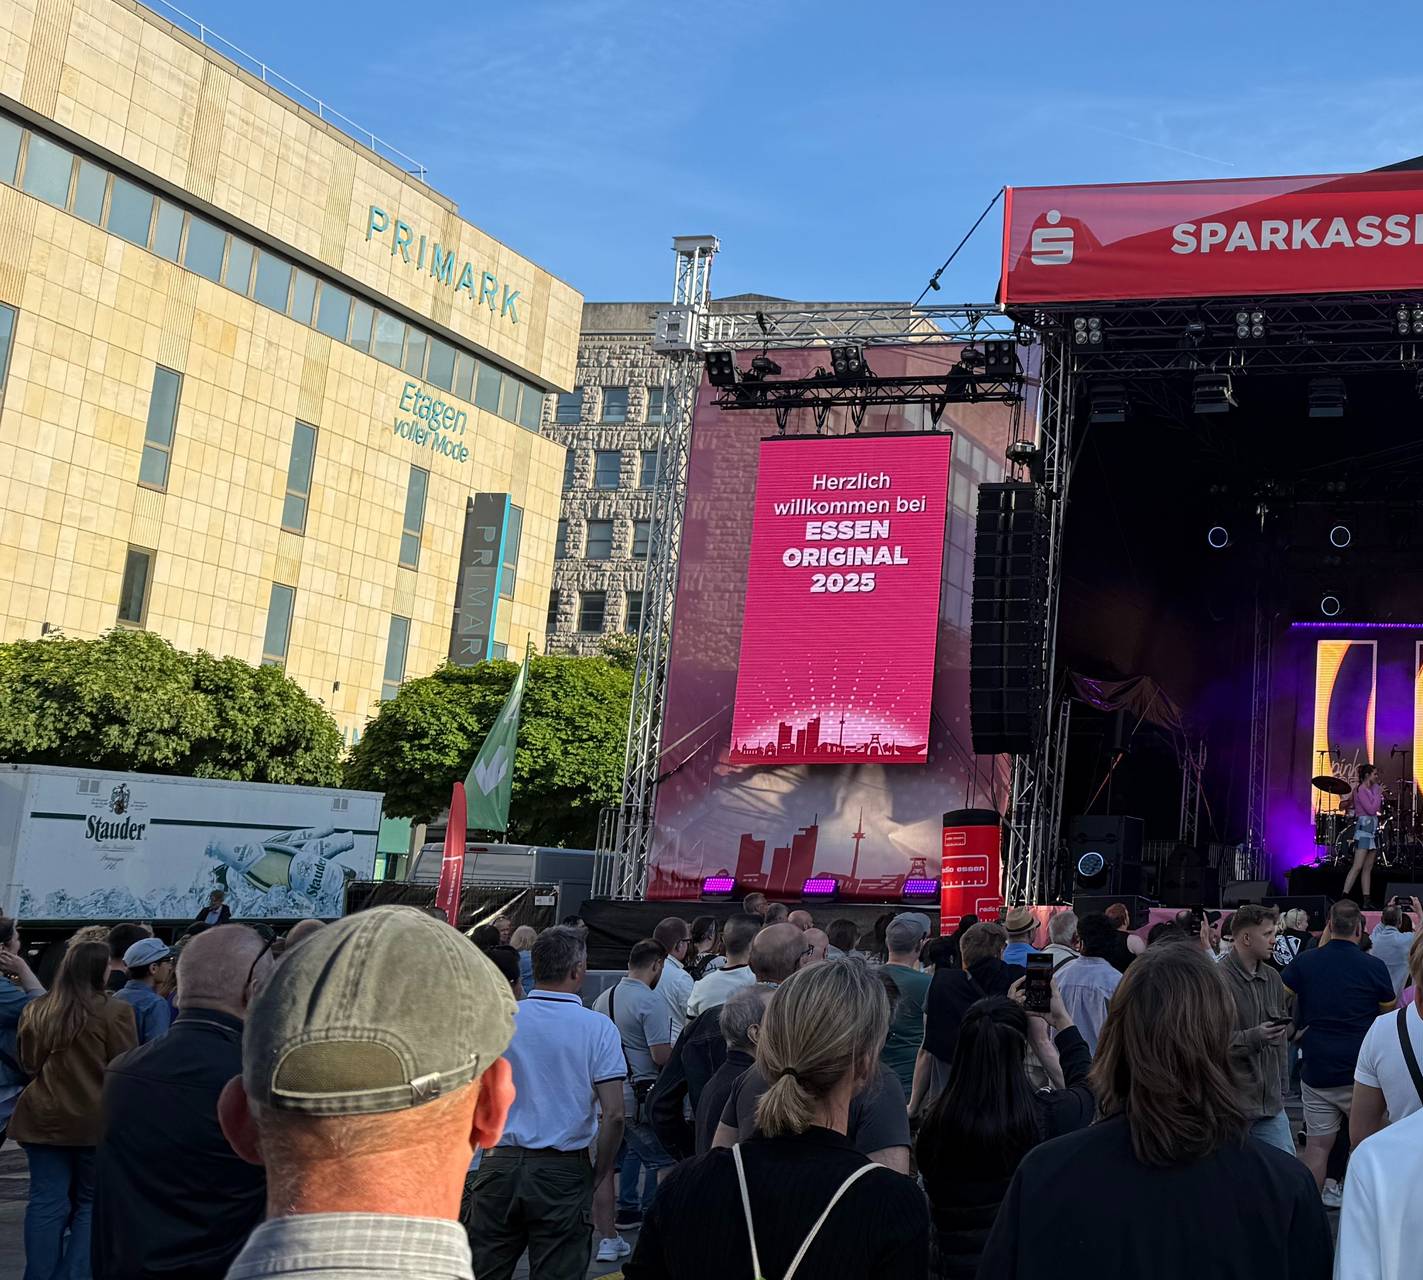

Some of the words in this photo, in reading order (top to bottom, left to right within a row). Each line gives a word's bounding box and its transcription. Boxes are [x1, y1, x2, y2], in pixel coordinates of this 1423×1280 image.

[365, 205, 521, 324] PRIMARK
[399, 381, 467, 436] Etagen
[393, 417, 432, 446] voller
[431, 431, 469, 463] Mode
[812, 472, 891, 491] Herzlich
[774, 498, 891, 516] willkommen
[896, 495, 927, 513] bei
[805, 519, 891, 541] ESSEN
[782, 545, 910, 568] ORIGINAL
[810, 572, 876, 594] 2025
[459, 526, 497, 667] PRIMAR
[85, 815, 146, 842] Stauder
